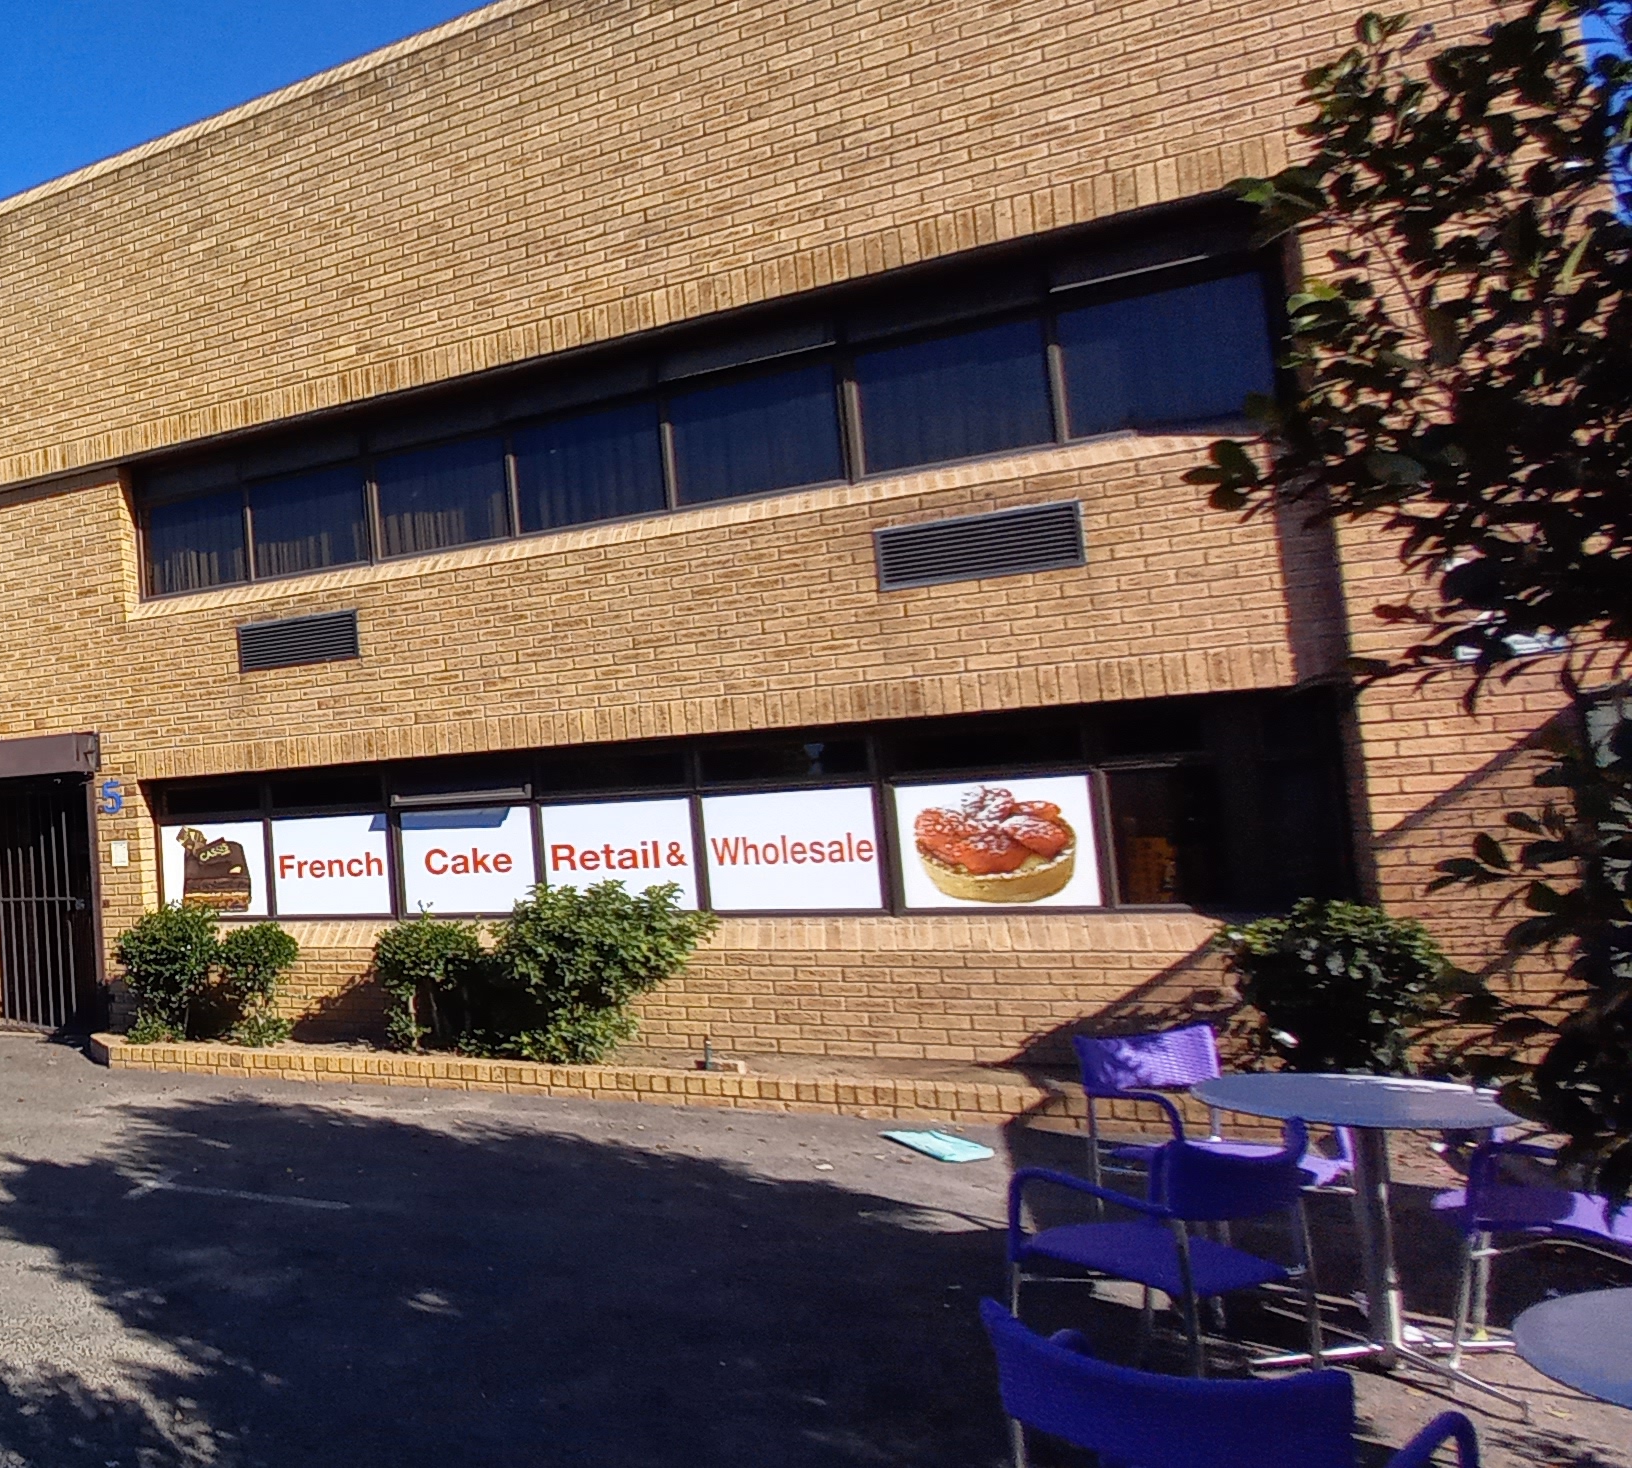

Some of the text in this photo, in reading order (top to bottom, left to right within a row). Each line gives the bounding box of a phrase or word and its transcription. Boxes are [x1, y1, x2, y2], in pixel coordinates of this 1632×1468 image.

[102, 780, 123, 814] 5
[278, 832, 874, 879] French Cake Retail & Wholesale
